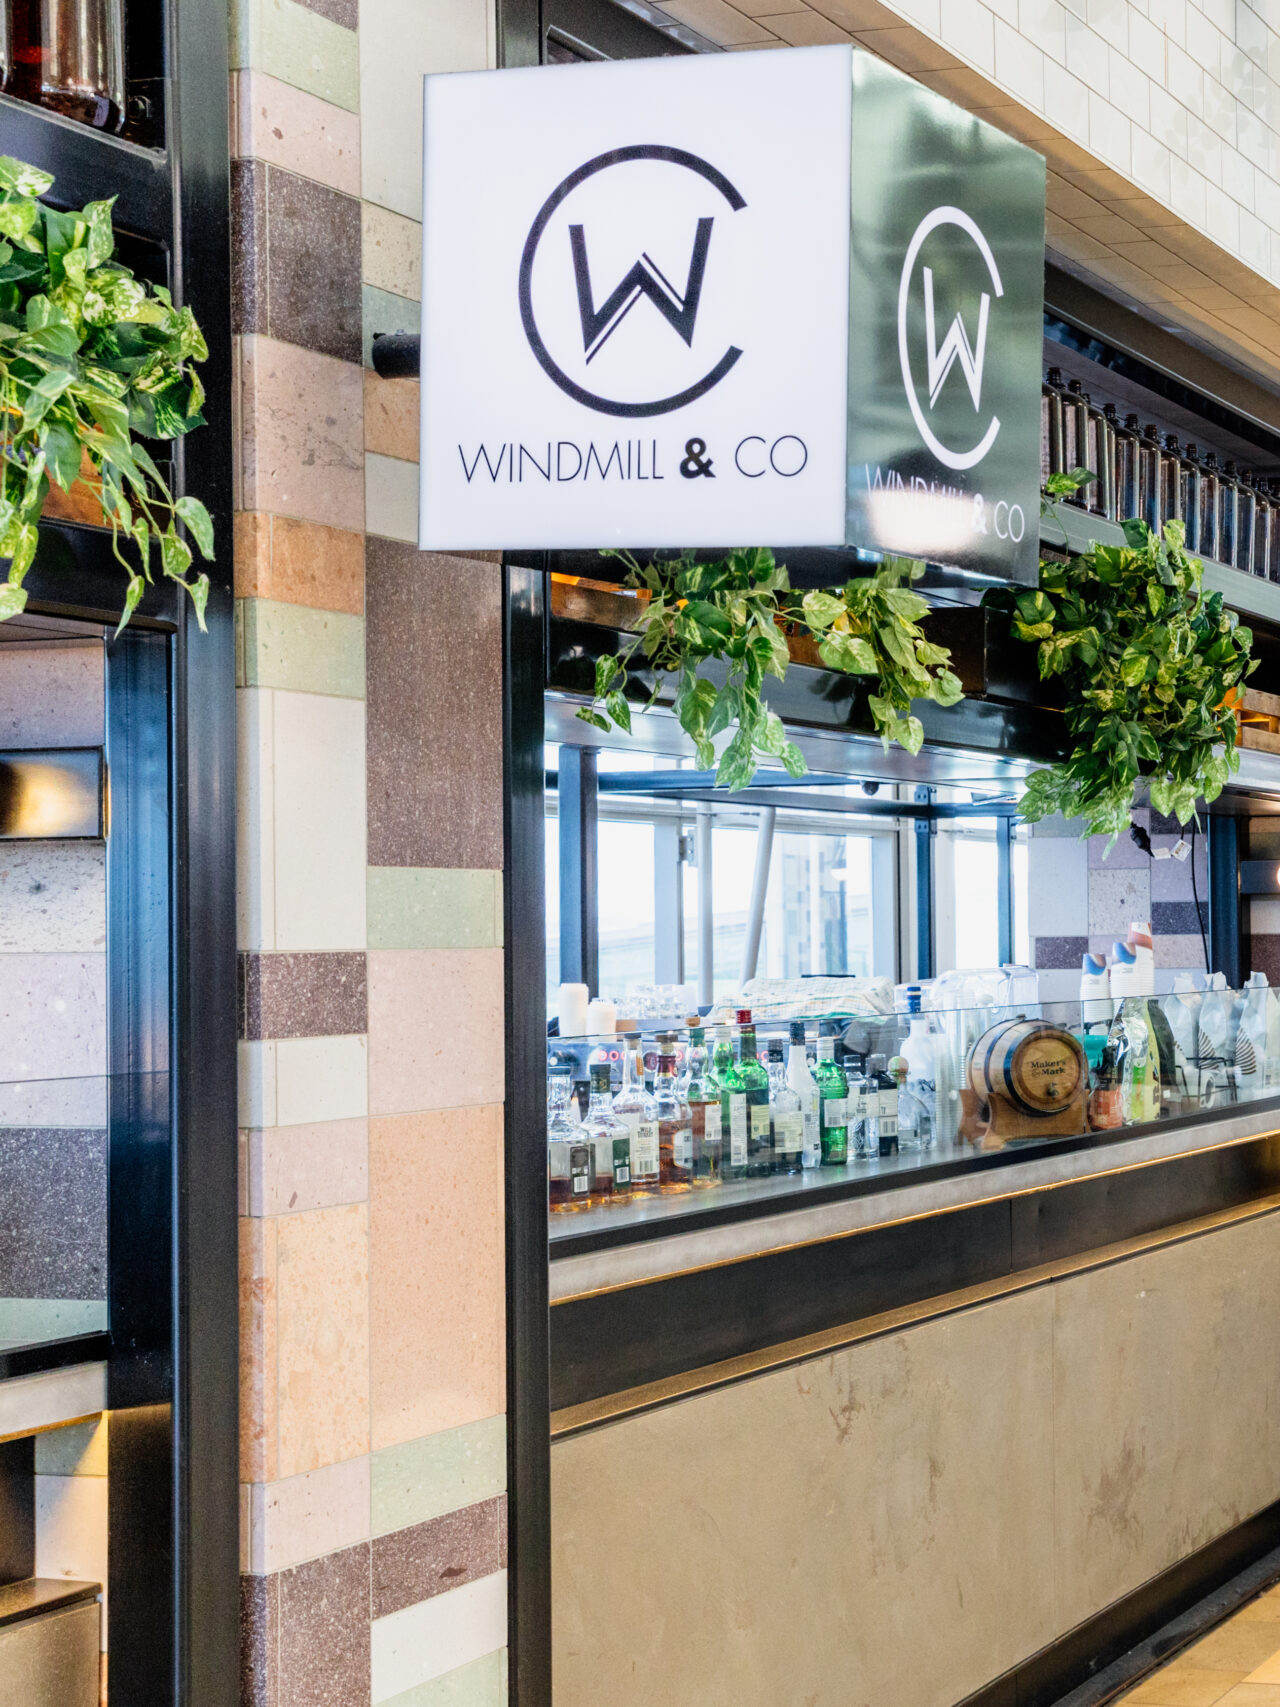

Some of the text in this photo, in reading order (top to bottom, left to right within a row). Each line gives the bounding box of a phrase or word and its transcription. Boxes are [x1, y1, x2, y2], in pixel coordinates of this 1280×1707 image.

[458, 435, 808, 483] WINDMILL & CO
[971, 493, 987, 535] &
[994, 500, 1025, 543] CO
